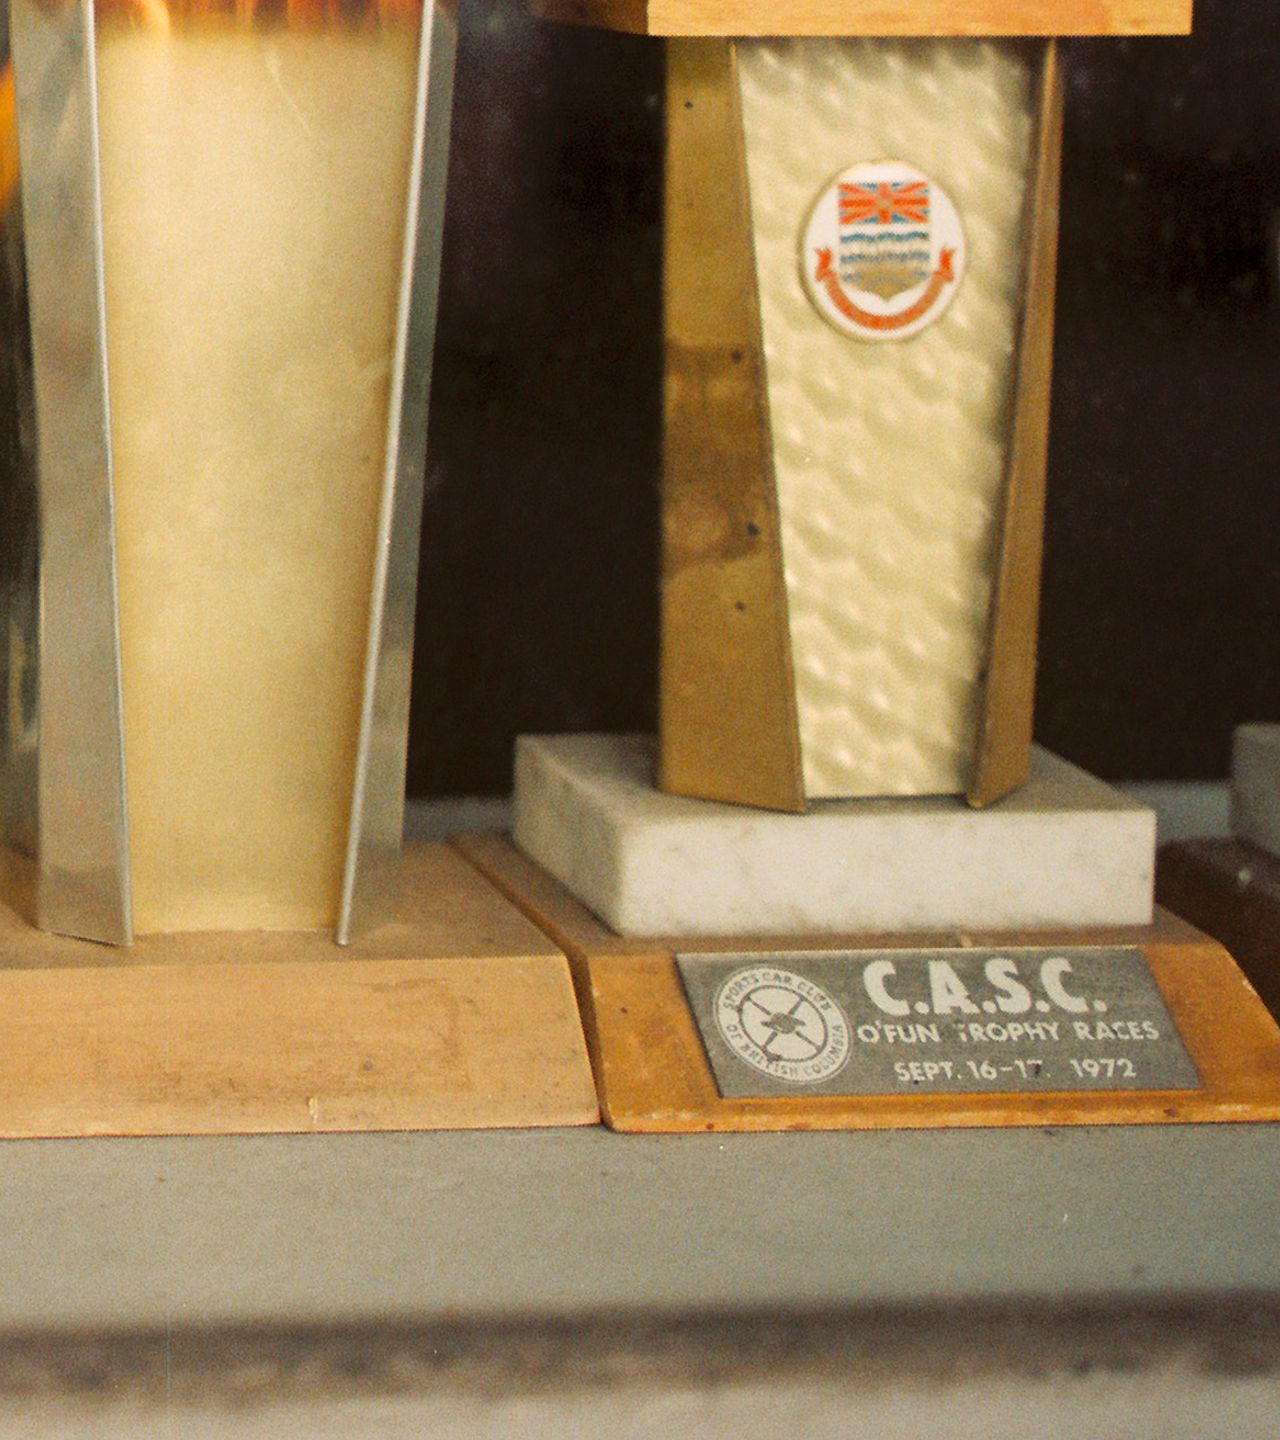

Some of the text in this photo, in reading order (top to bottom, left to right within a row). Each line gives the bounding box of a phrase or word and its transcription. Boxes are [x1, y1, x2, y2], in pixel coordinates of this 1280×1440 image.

[723, 971, 833, 1012] SPORTS CAR CLUB
[863, 957, 1108, 1016] C.A.S.C.
[726, 1024, 744, 1041] OF
[803, 1023, 845, 1078] COLUMBIA
[857, 1020, 1160, 1044] O'FUN TROPHY RACES
[894, 1060, 962, 1082] SEPT.
[1069, 1057, 1138, 1079] 1972
